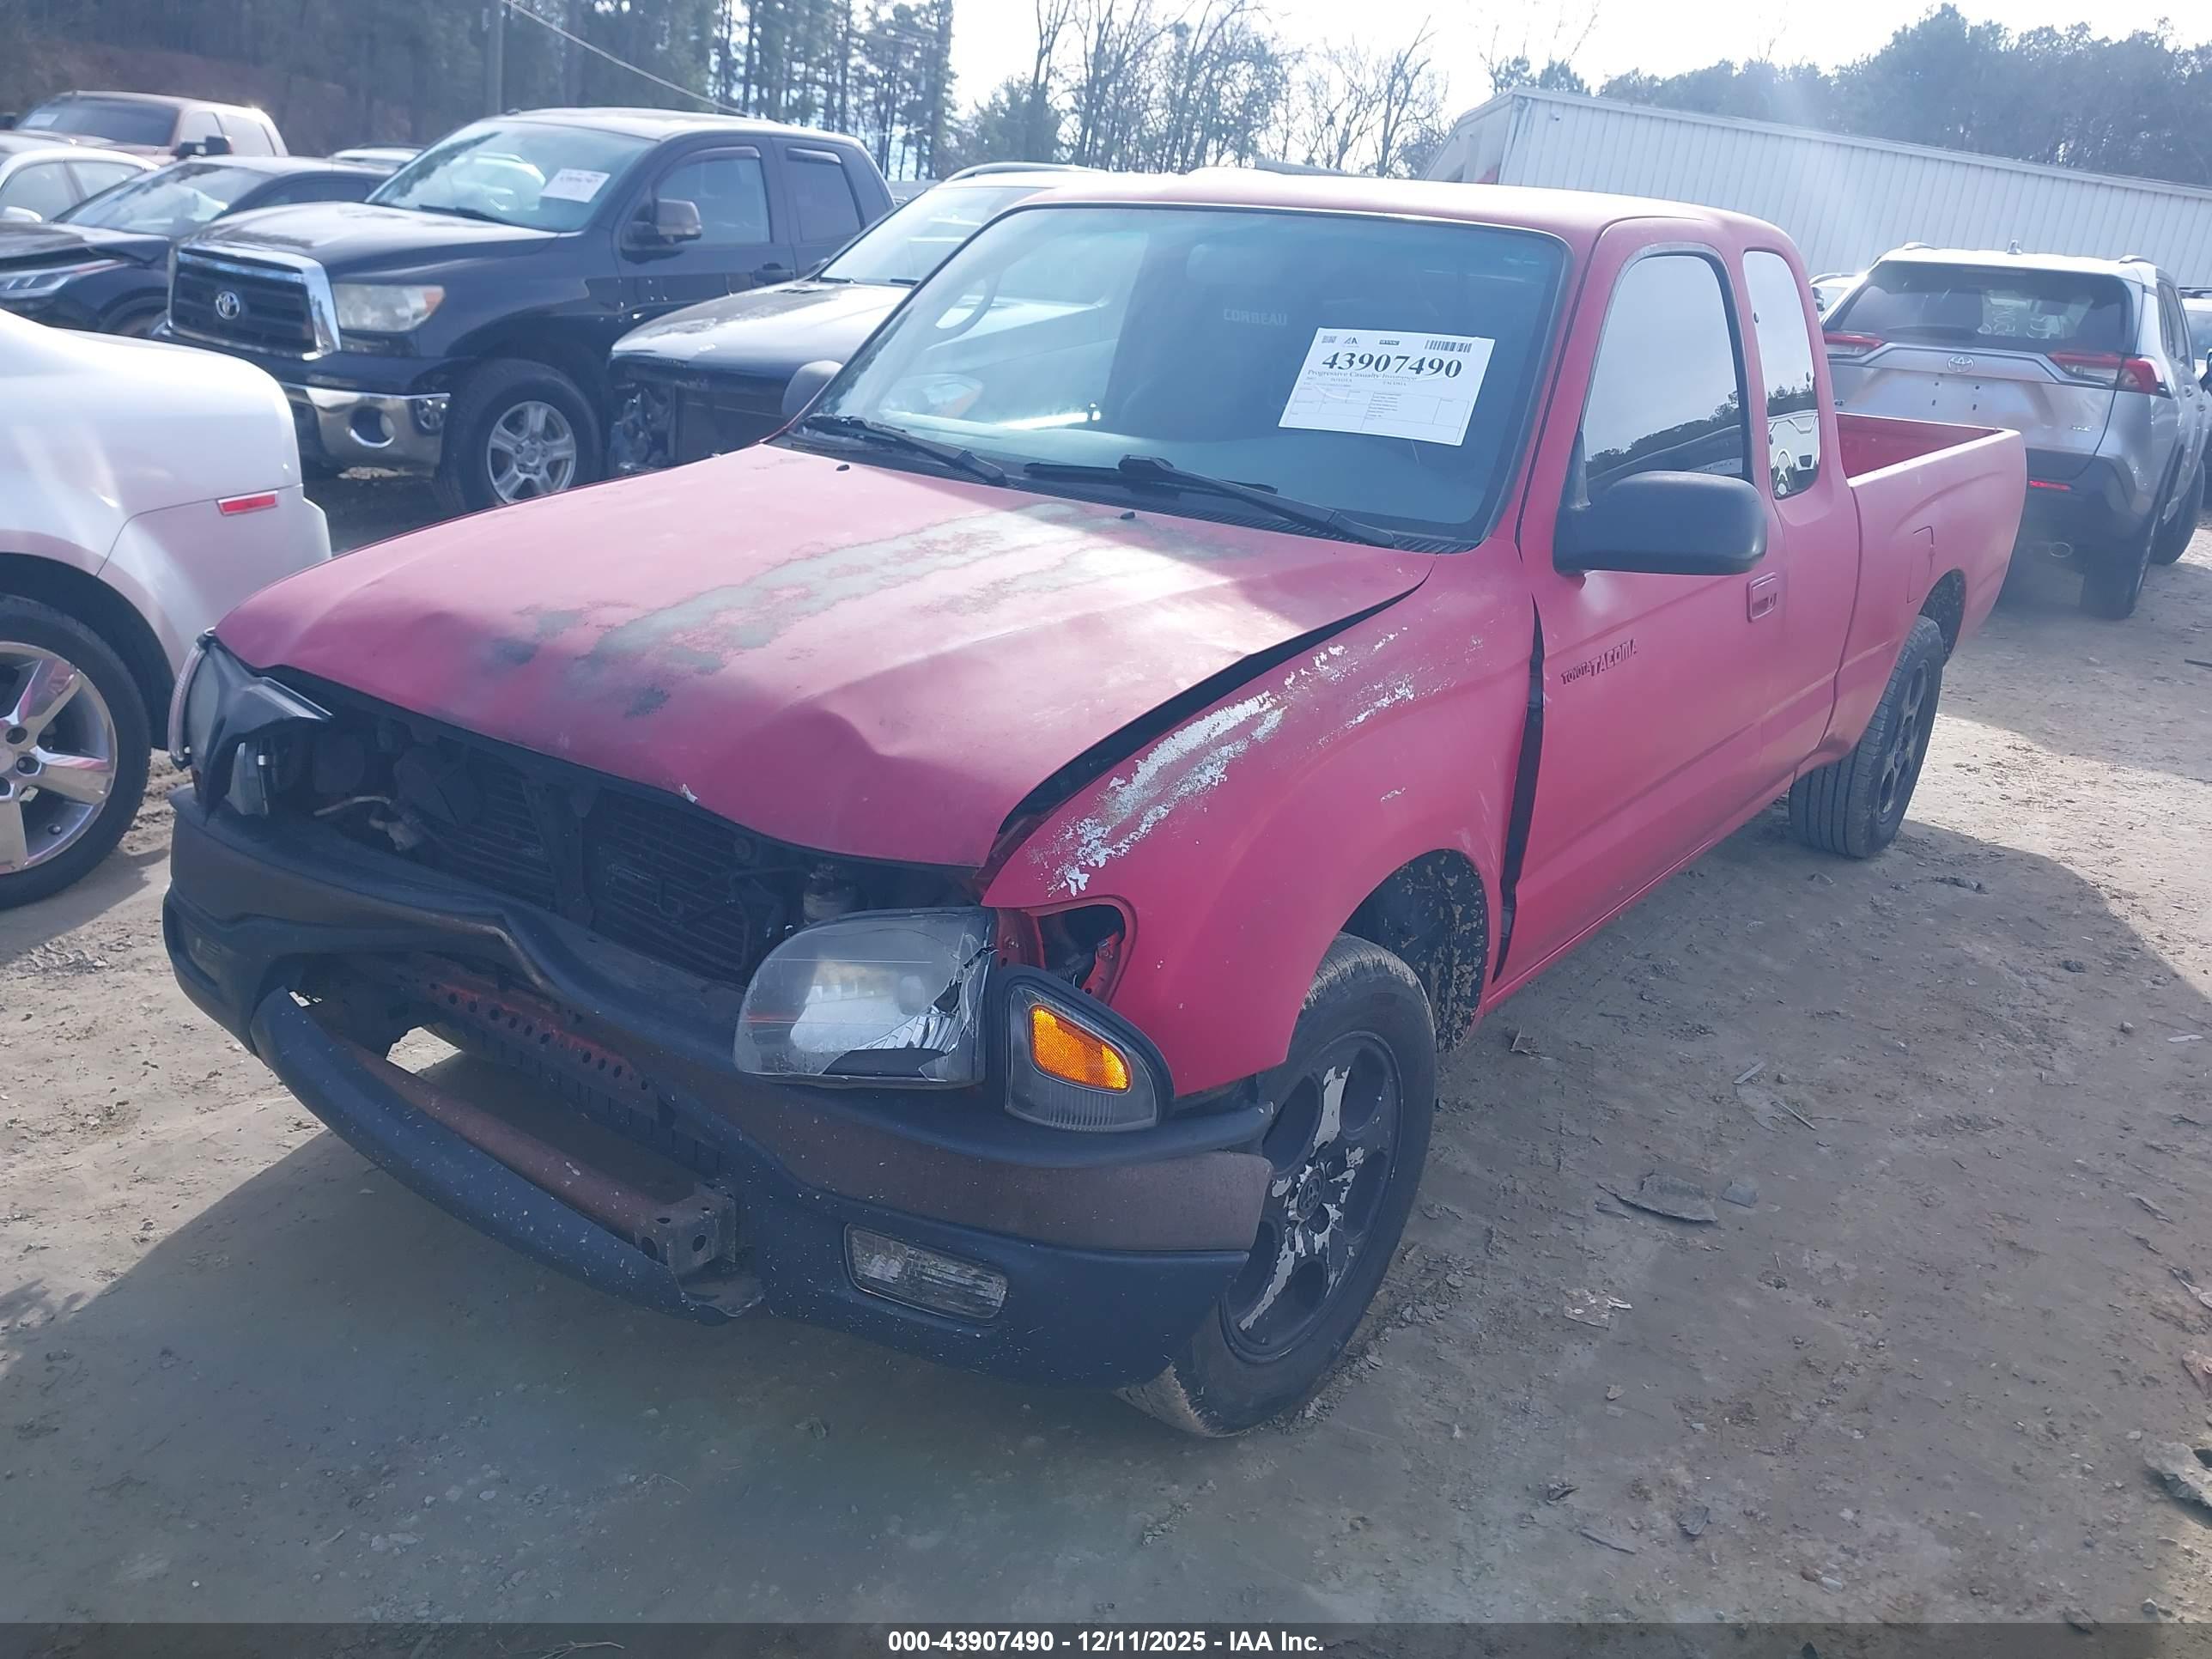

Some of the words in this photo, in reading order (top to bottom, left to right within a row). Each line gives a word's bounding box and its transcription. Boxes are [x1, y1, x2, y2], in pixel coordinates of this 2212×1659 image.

[1223, 308, 1287, 325] CORBEAU
[1308, 369, 1348, 378] Progressive
[1349, 371, 1381, 380] Casualty
[1322, 351, 1462, 379] 43907490
[1561, 660, 1591, 684] TOYOTA
[1590, 638, 1638, 677] TACOMA
